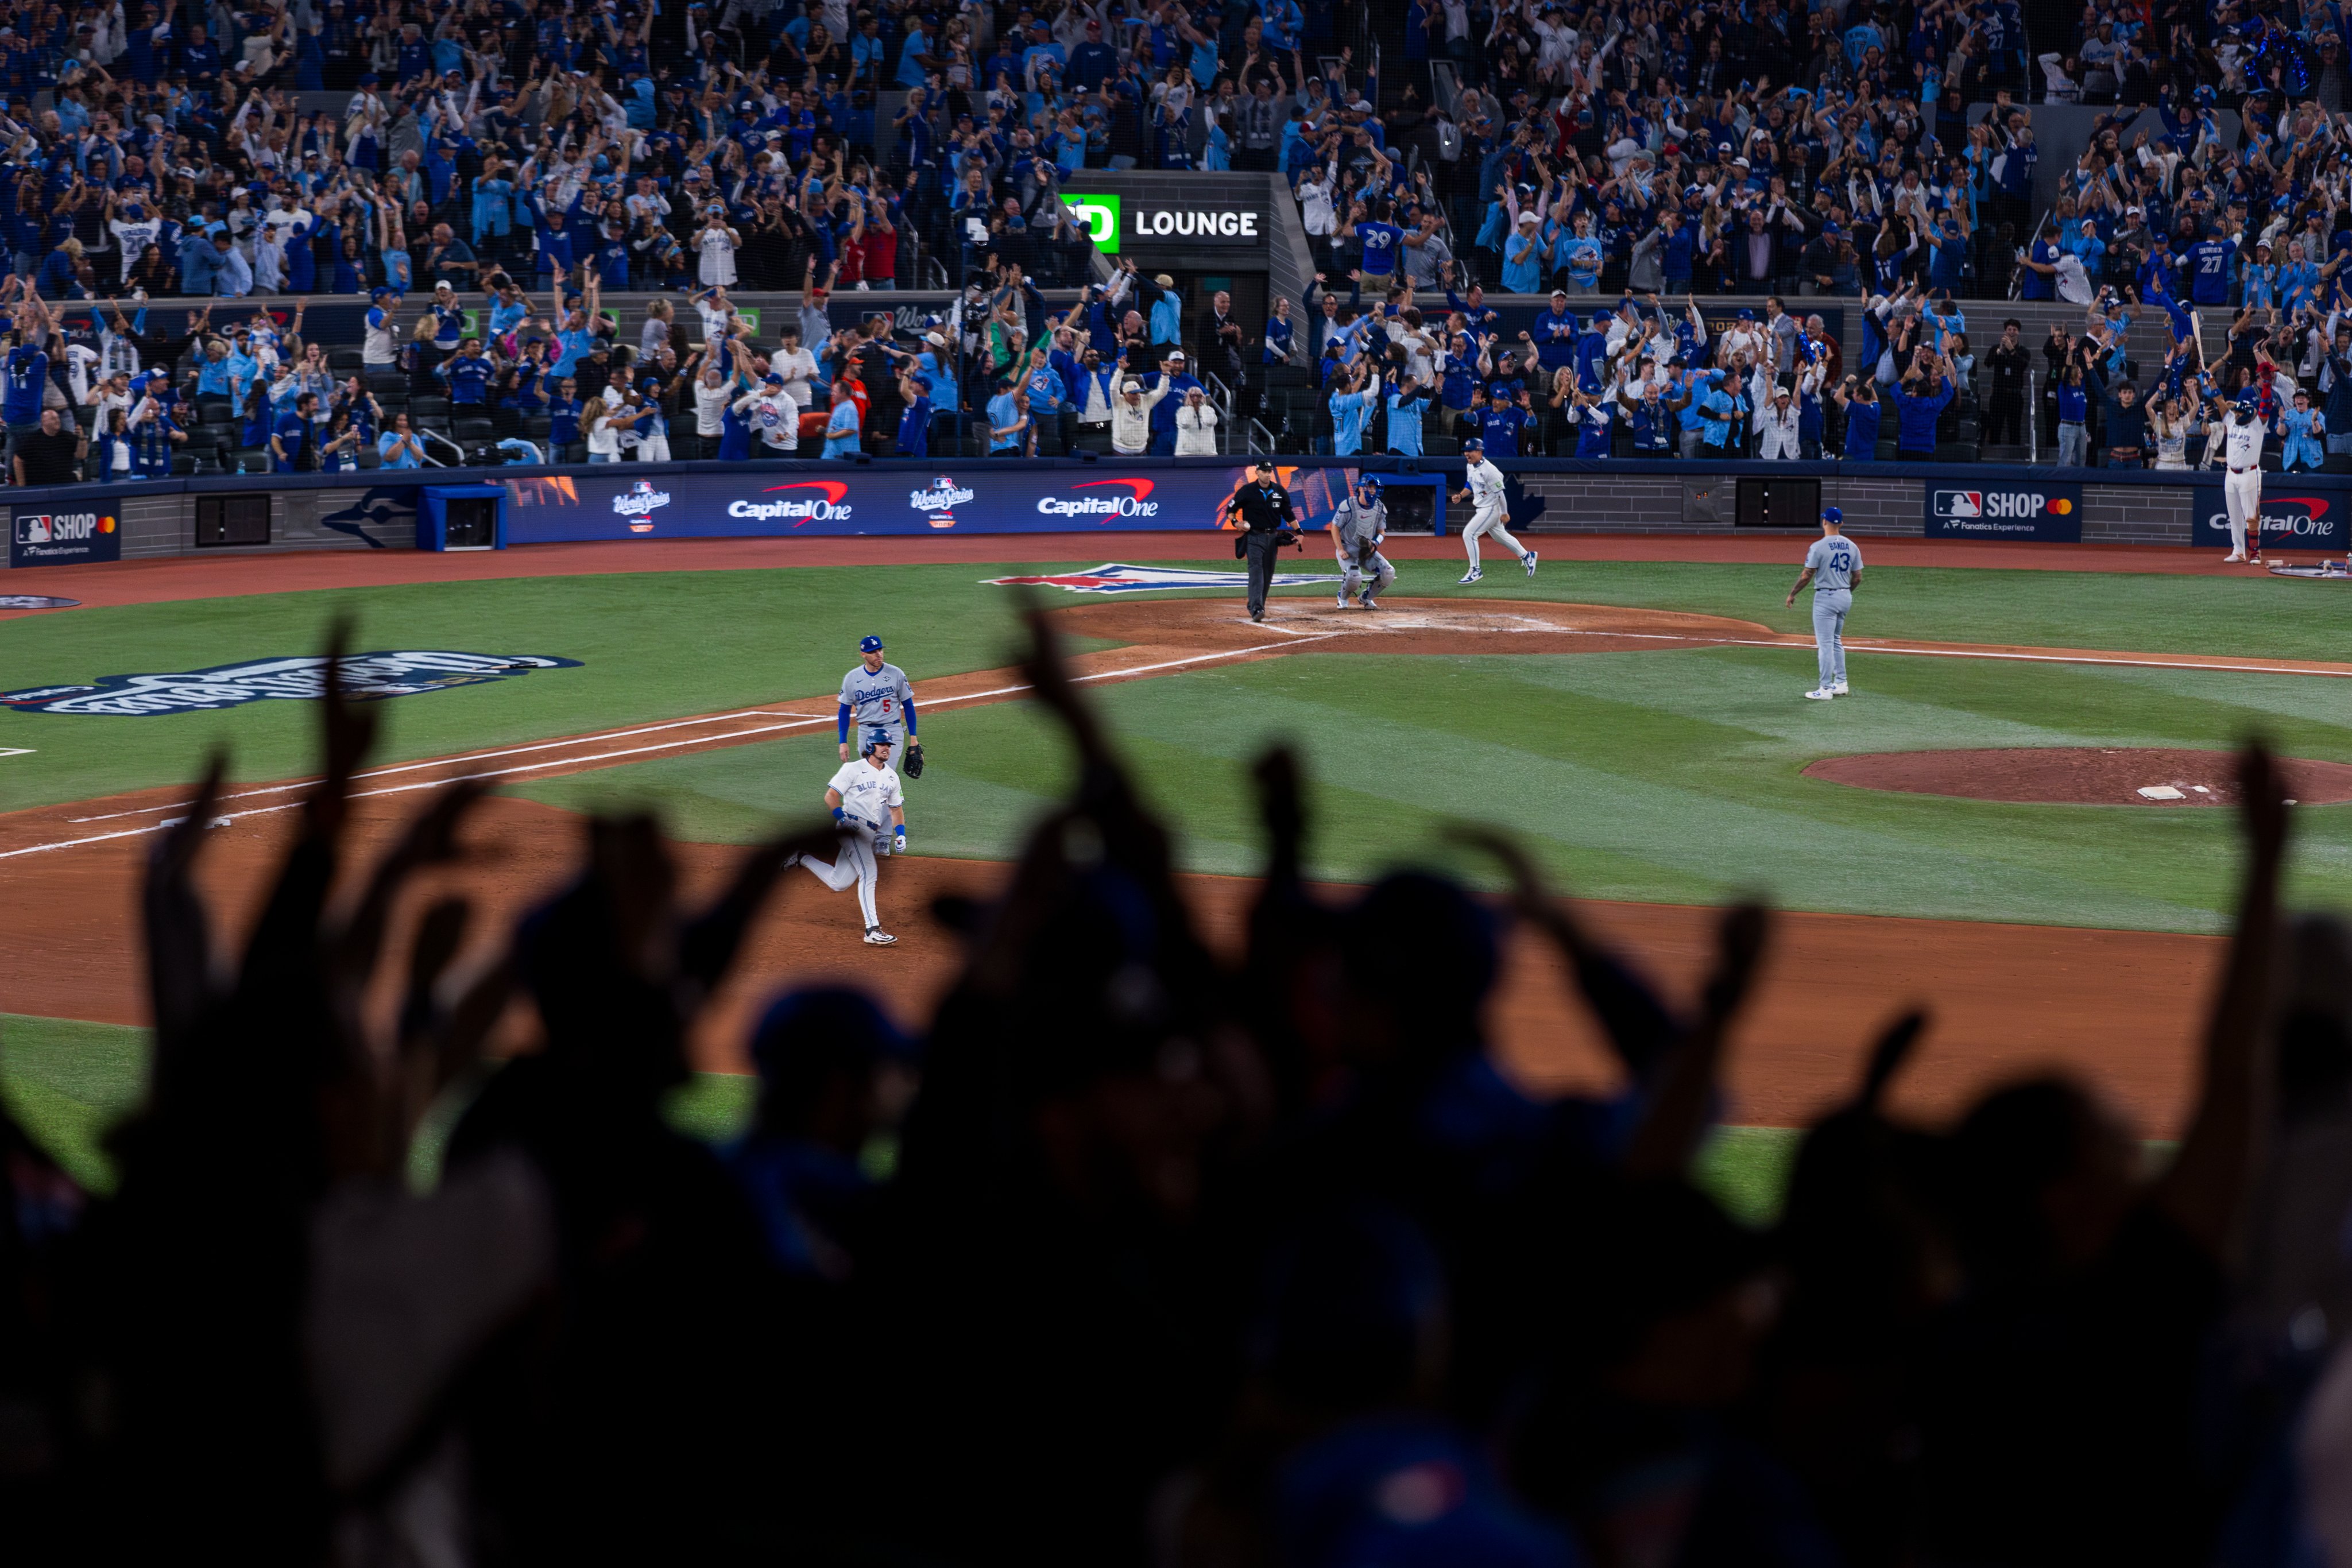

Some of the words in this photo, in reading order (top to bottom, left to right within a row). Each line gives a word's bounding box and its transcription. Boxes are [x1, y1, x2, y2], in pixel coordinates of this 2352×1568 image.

[1066, 204, 1114, 242] D
[1136, 211, 1258, 236] LOUNGE
[1365, 229, 1391, 249] 29
[2200, 255, 2222, 273] 27
[910, 489, 945, 508] World
[941, 488, 973, 510] Series
[1986, 493, 2045, 518] SHOP
[54, 513, 96, 539] SHOP
[1961, 522, 1992, 531] Fanatics
[1993, 523, 2034, 532] Experience
[59, 546, 90, 555] Experience
[1830, 552, 1850, 571] 43
[855, 686, 894, 702] Dodgers
[883, 699, 891, 712] 5
[857, 781, 877, 792] BLUE
